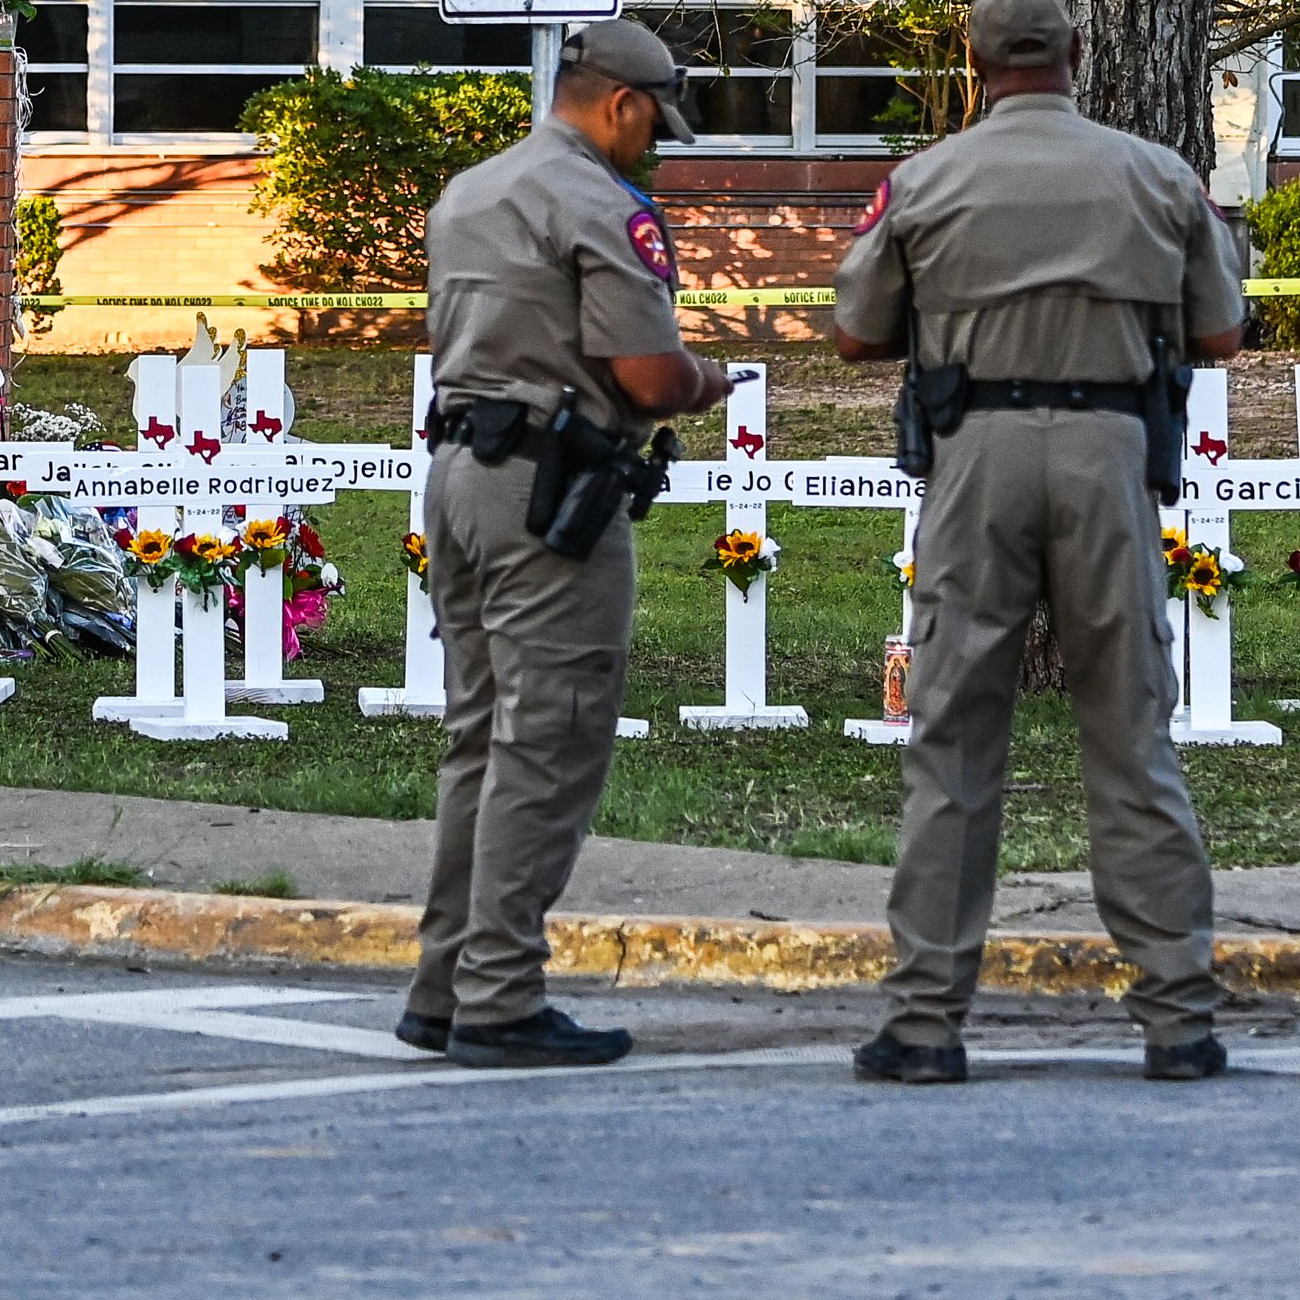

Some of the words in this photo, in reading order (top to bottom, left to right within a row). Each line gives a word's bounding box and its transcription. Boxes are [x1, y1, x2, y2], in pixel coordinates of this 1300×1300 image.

[74, 477, 200, 498] Annabelle
[208, 476, 334, 498] Rodriguez
[741, 470, 772, 492] Jo
[187, 508, 221, 516] 5-24-22
[1191, 517, 1225, 525] 5-24-22
